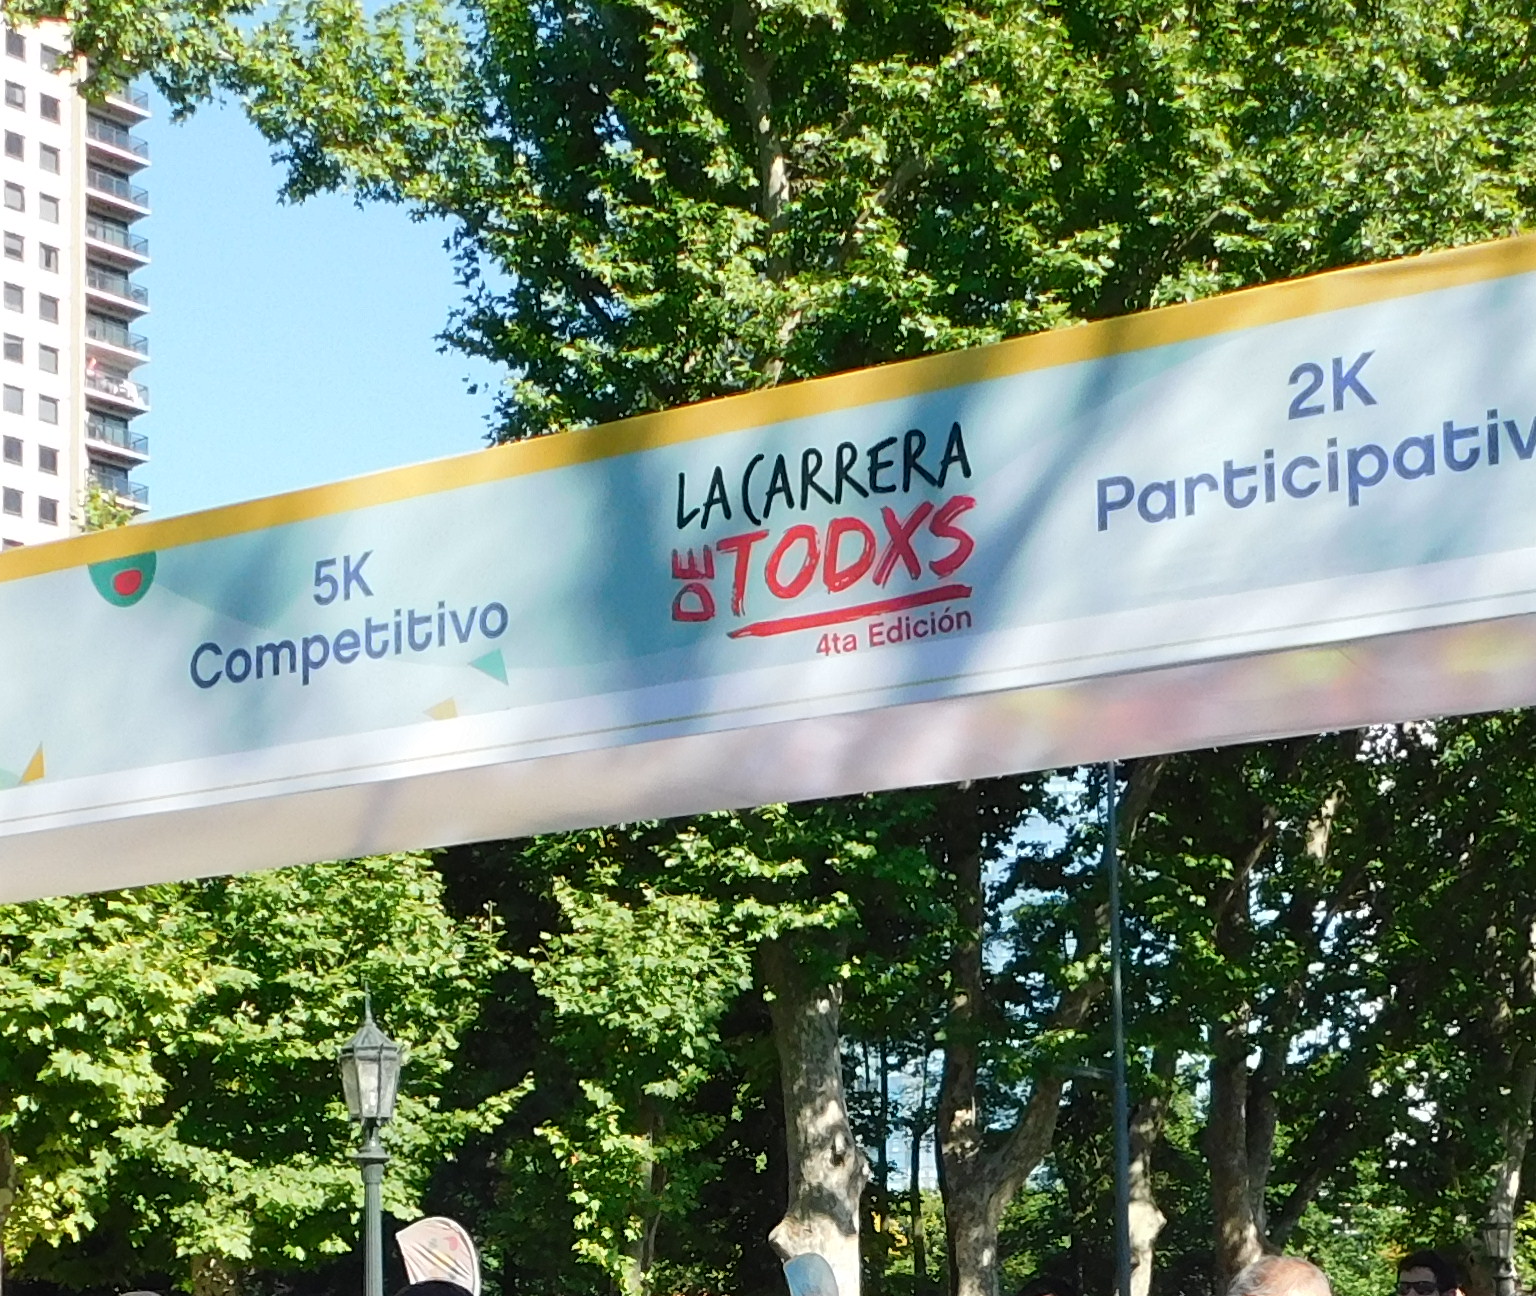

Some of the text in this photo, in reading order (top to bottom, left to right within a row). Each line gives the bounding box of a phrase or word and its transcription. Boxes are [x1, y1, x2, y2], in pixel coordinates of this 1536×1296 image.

[1287, 350, 1378, 421] 2K
[313, 550, 375, 606] 5K
[671, 495, 976, 622] DE TODXS
[190, 600, 509, 690] Competitivo
[816, 607, 972, 656] 4ta Edición
